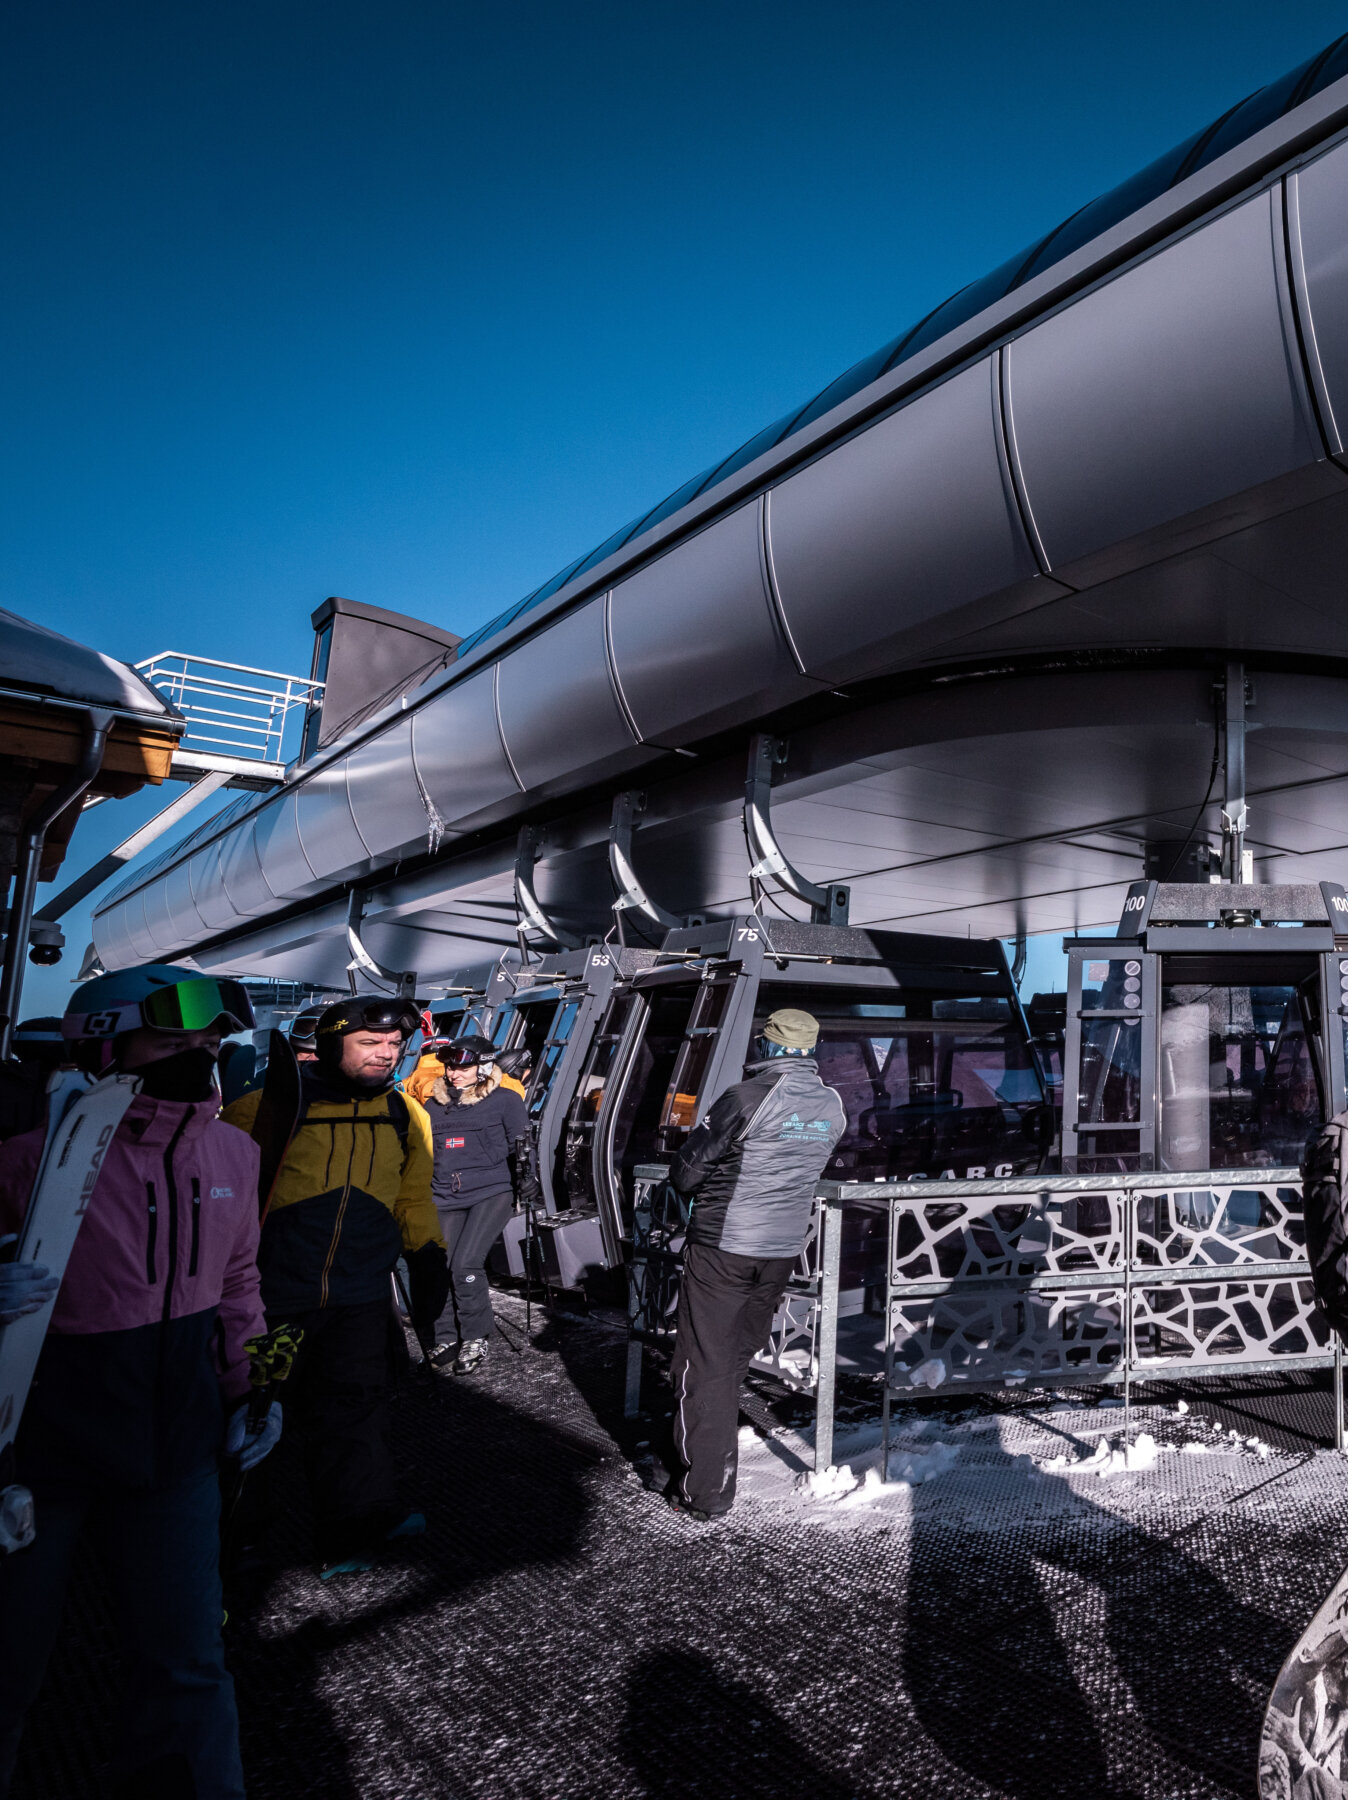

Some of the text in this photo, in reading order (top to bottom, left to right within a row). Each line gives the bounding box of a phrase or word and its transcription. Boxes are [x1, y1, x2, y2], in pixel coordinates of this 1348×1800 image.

[1124, 895, 1146, 912] 100
[737, 928, 759, 942] 75
[591, 954, 611, 967] 53
[74, 1124, 114, 1216] HEAD
